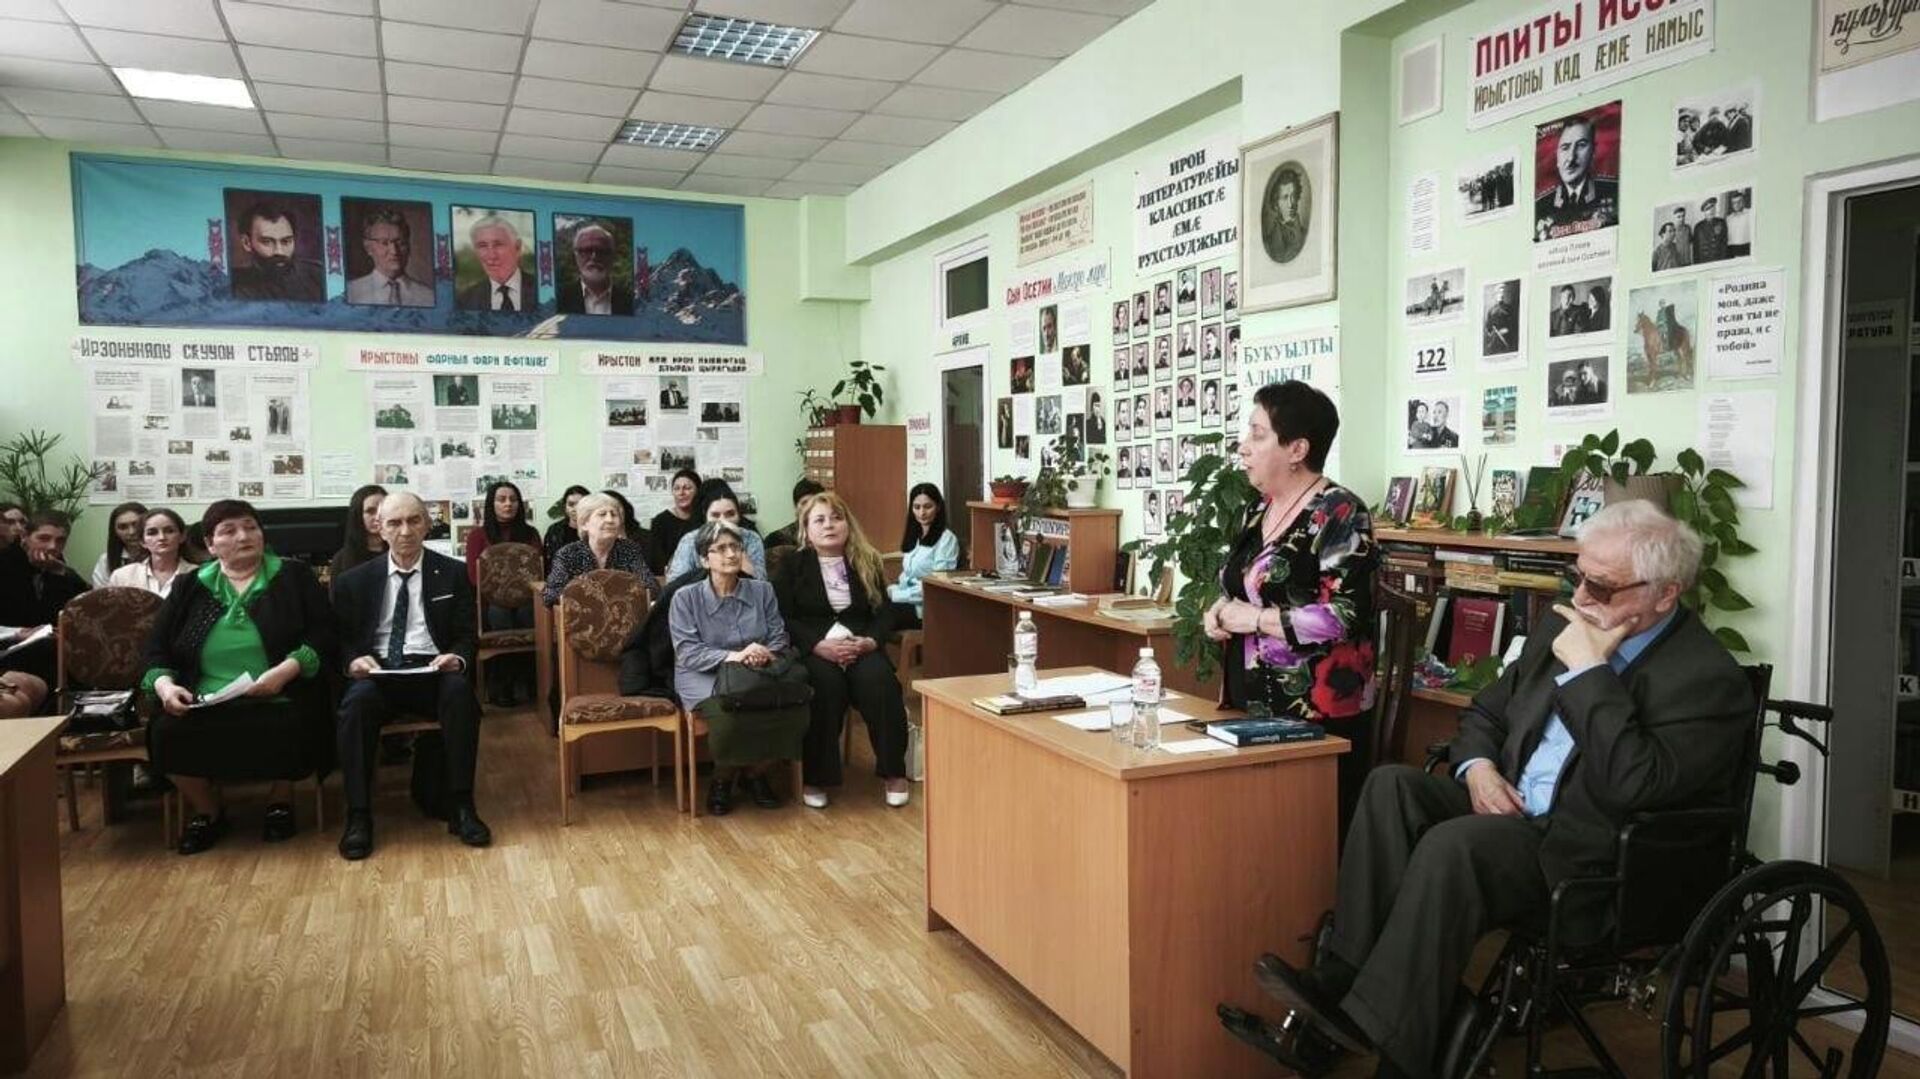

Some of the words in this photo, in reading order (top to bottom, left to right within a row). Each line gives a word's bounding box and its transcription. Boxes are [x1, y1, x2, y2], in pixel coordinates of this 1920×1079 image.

[1554, 53, 1581, 86] КАД
[1646, 8, 1704, 54] НАМЫС
[1170, 149, 1206, 176] ИРОН
[360, 350, 419, 366] ИРЫСТОНЫ
[598, 353, 641, 367] ИРЫСТОН
[1243, 336, 1333, 364] БУКУЫЛТЫ
[1417, 348, 1446, 369] 122
